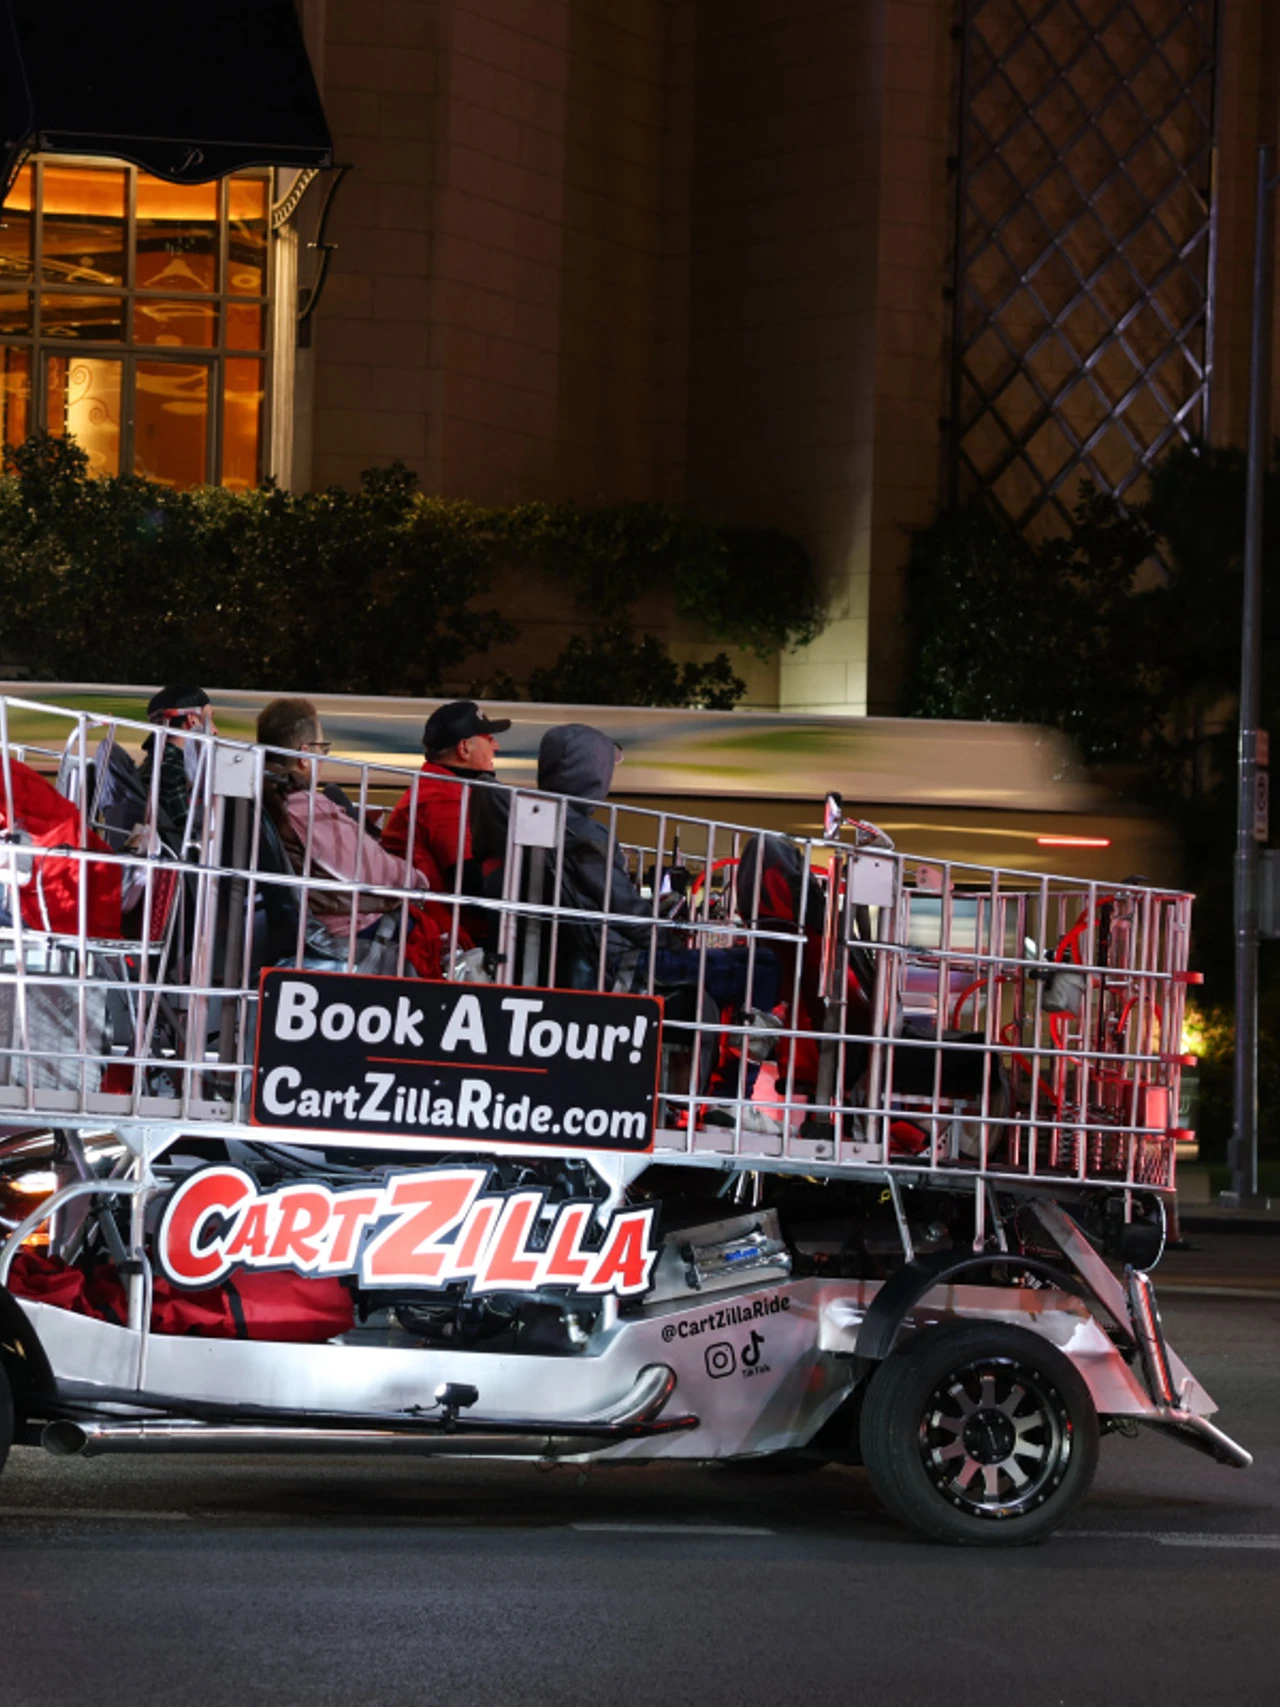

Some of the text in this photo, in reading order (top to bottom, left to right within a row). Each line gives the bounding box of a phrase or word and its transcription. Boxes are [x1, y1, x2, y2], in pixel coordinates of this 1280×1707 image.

[274, 981, 649, 1064] Book A Tour!
[262, 1066, 647, 1140] CartZillaRide.com
[661, 1296, 791, 1342] @CartZillaRide
